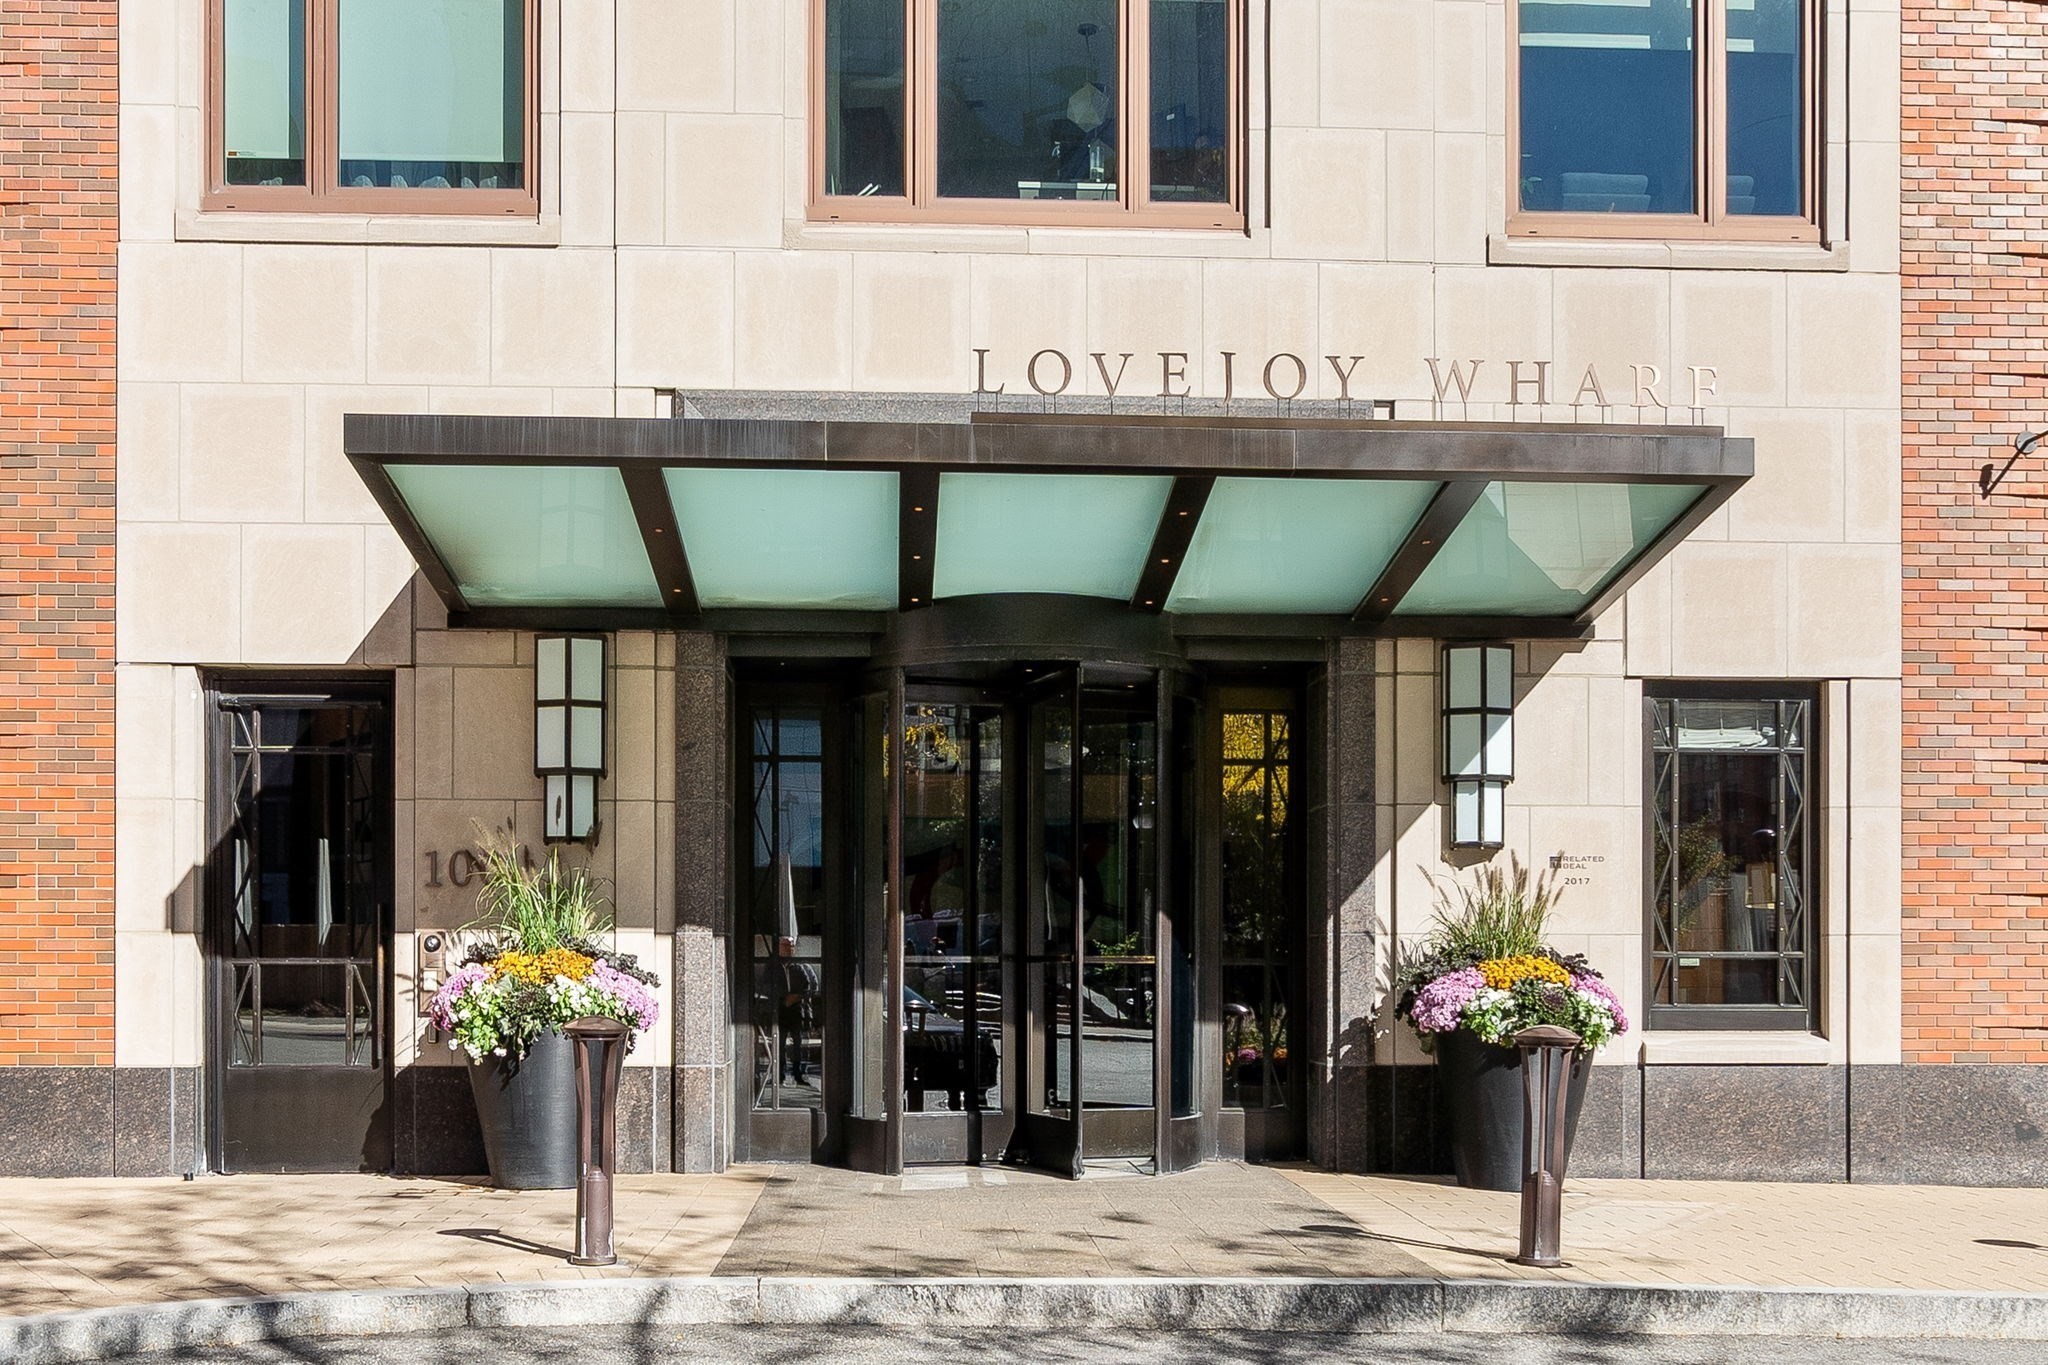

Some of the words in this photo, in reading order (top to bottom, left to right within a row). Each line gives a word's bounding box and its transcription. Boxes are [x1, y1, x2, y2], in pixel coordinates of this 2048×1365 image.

[972, 348, 1365, 403] LOVEJOY
[1424, 357, 1718, 409] WHARF
[1562, 855, 1605, 863] RELATED
[1564, 877, 1591, 885] 2017
